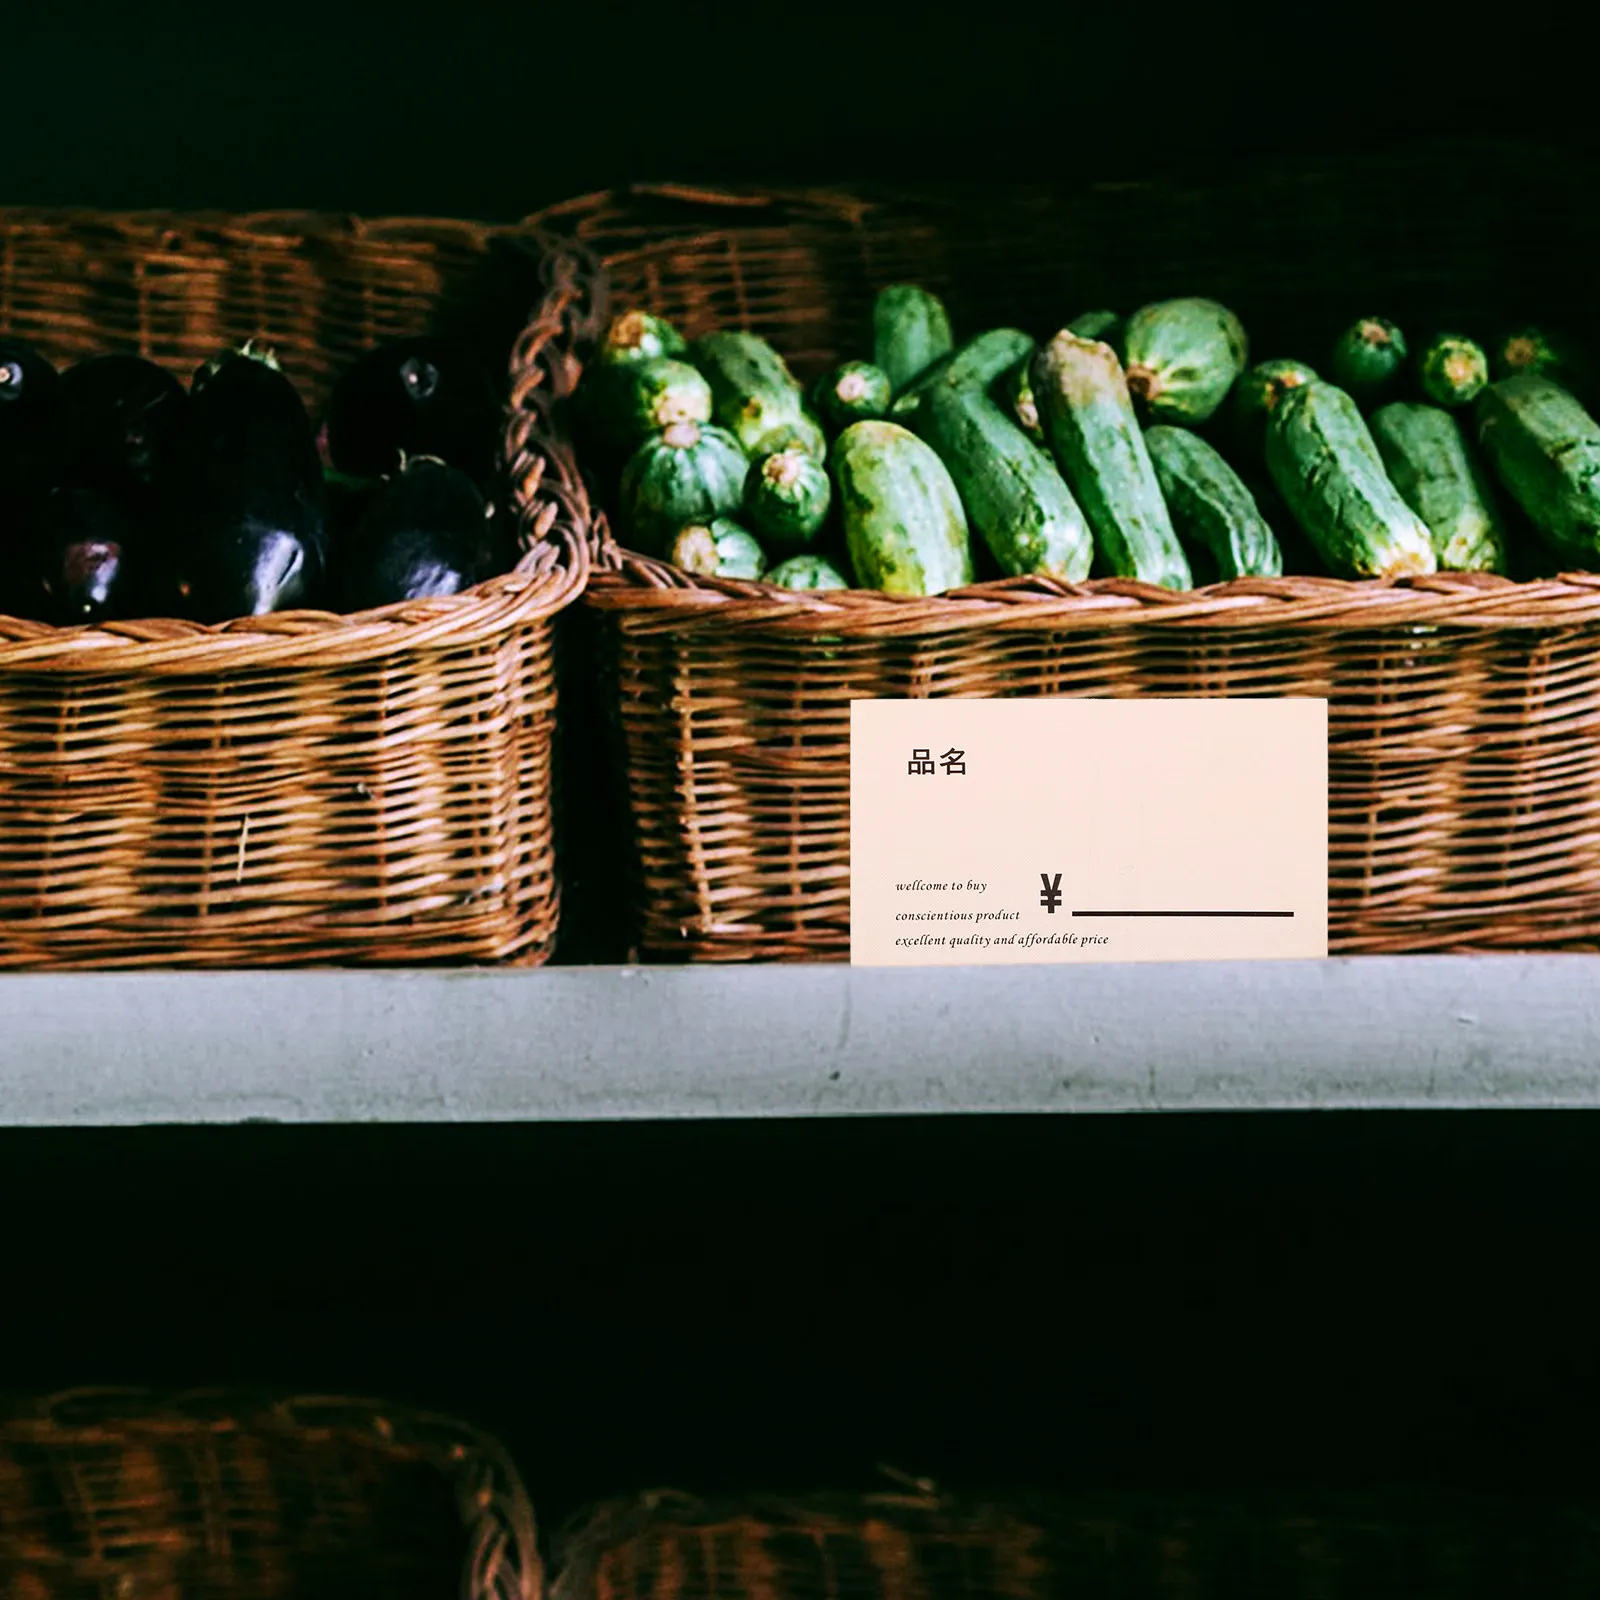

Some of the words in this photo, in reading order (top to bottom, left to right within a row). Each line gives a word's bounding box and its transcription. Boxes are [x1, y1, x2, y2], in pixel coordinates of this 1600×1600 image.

[907, 748, 967, 775] 品名
[895, 879, 948, 891] wellcome
[951, 882, 964, 891] to
[966, 879, 988, 894] buy
[1040, 873, 1063, 914] ¥
[895, 910, 974, 921] conscientious
[975, 909, 1021, 923] product
[895, 934, 947, 947] excellent
[949, 934, 992, 948] quality
[993, 934, 1017, 946] and
[1017, 933, 1078, 948] affordable
[1080, 934, 1110, 948] price
